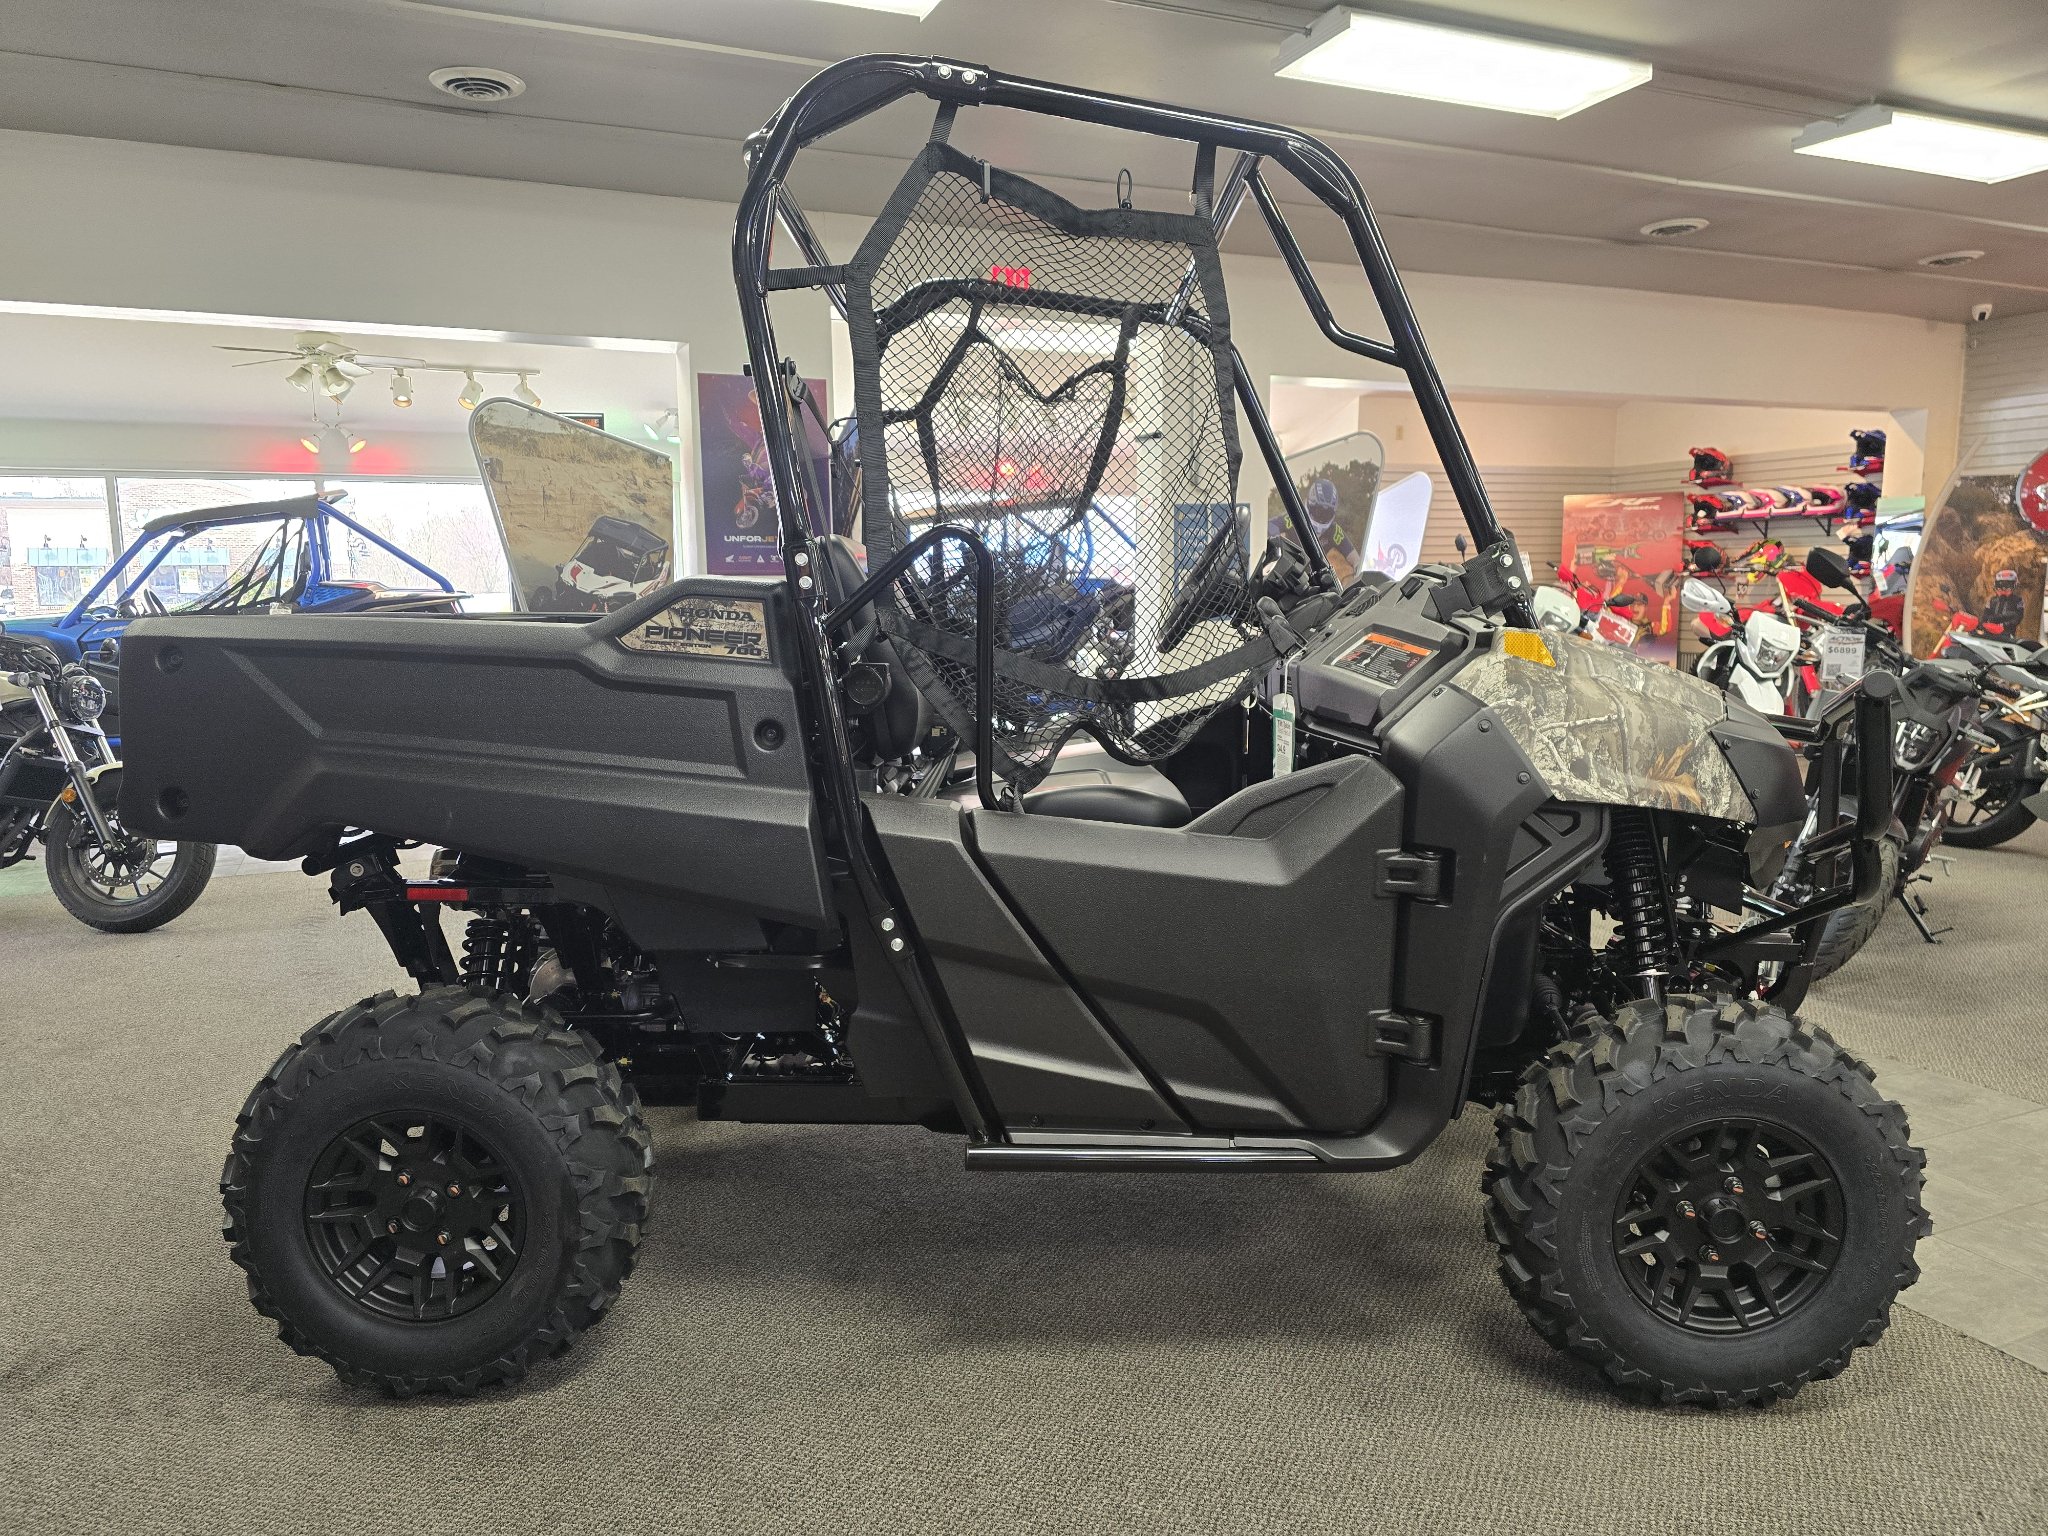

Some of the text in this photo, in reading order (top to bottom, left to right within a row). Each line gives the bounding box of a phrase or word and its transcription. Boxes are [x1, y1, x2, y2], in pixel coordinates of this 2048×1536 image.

[679, 607, 756, 622] HONDA
[645, 625, 762, 646] PIONEER
[724, 645, 762, 656] 700
[1653, 1077, 1789, 1120] KENDA
